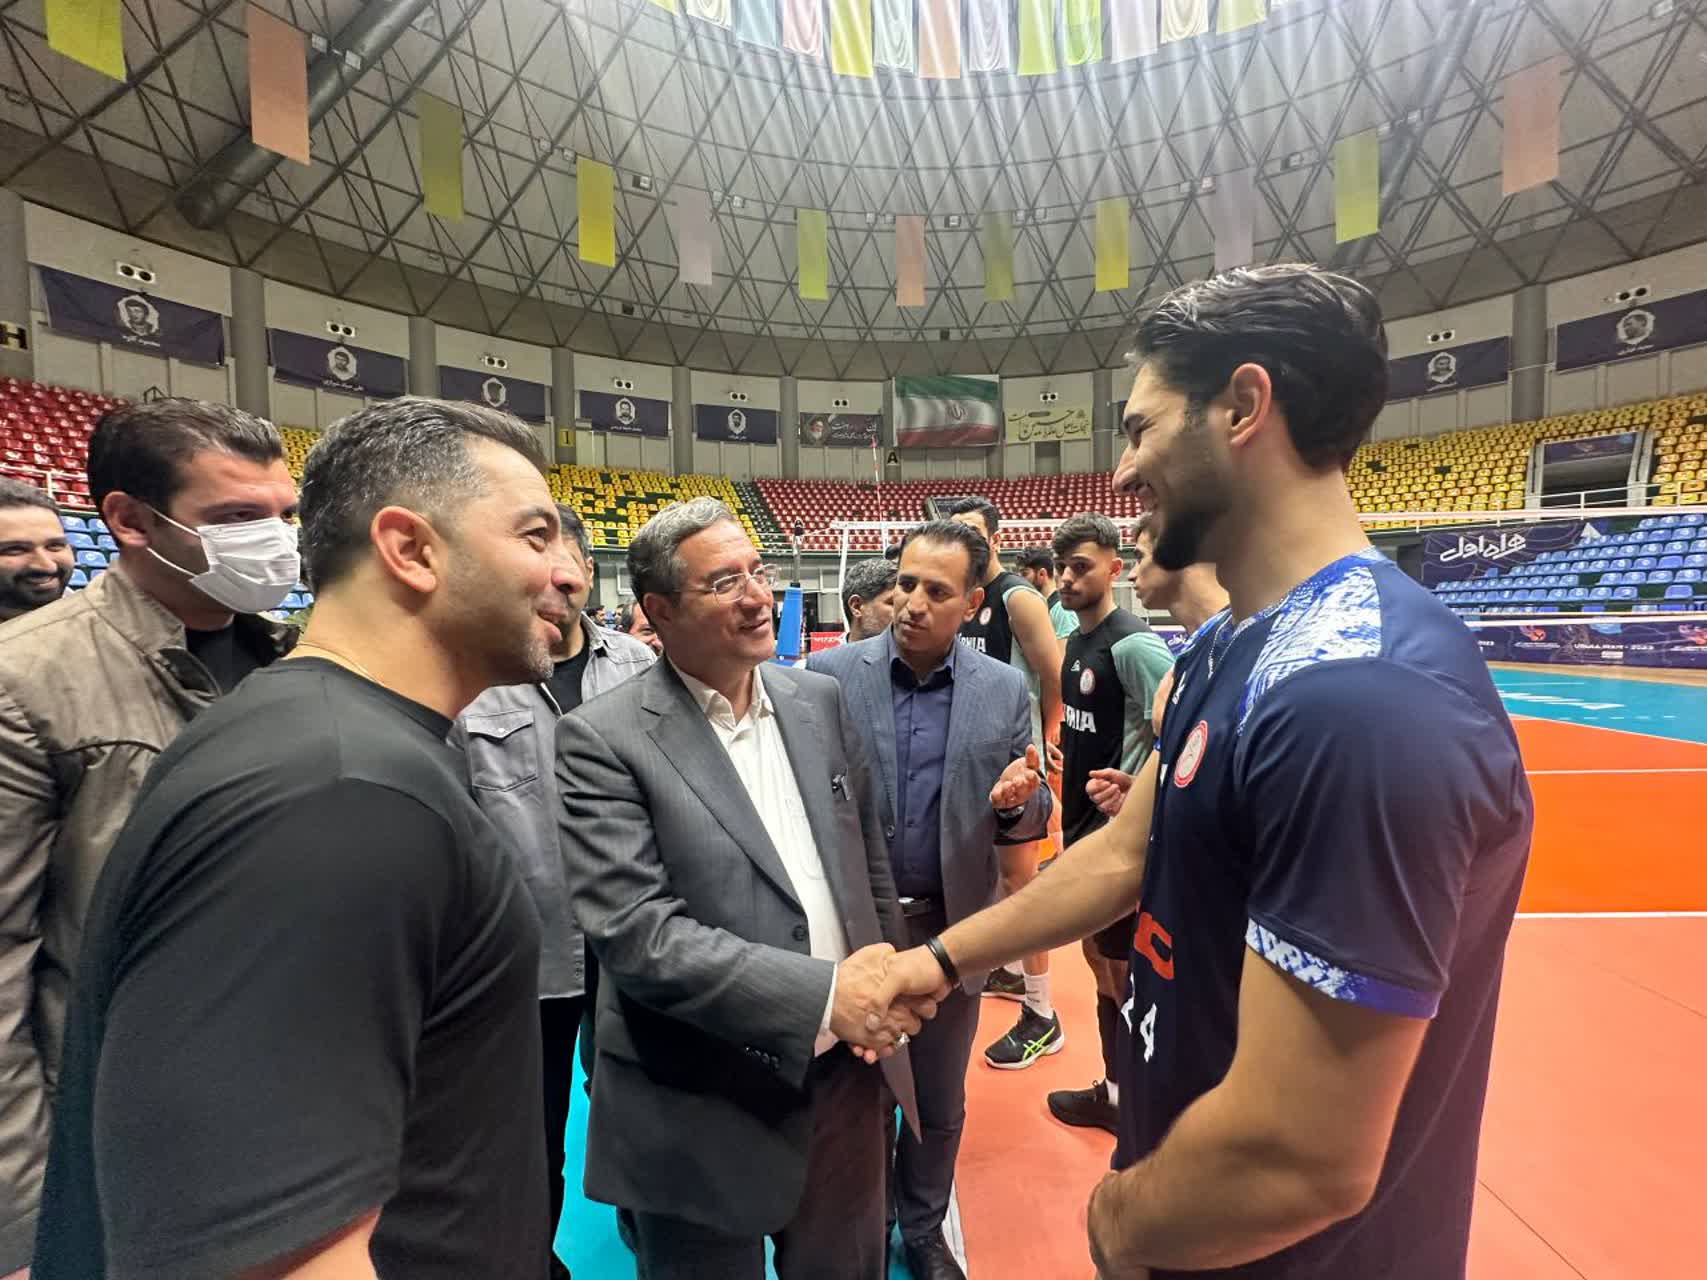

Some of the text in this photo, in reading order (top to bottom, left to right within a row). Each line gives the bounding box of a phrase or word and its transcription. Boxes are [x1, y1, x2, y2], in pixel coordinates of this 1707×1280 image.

[887, 452, 898, 464] A
[1440, 533, 1527, 562] همراه اول
